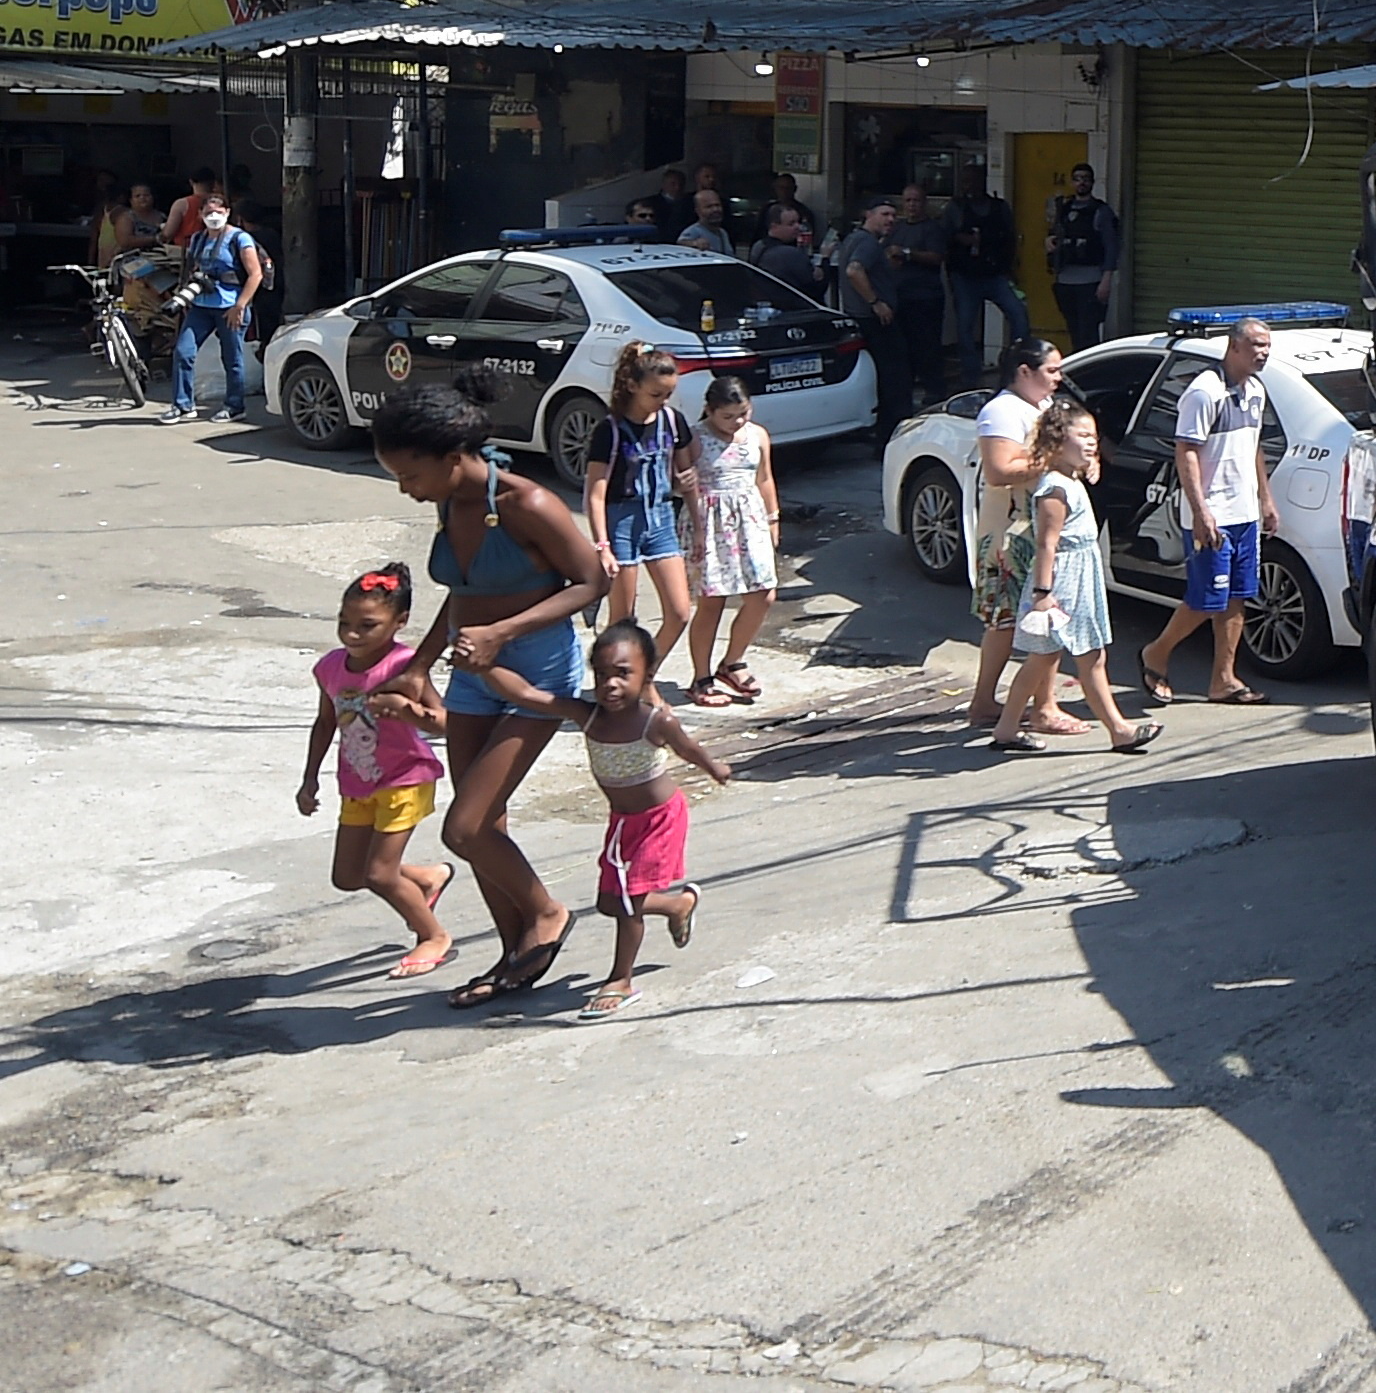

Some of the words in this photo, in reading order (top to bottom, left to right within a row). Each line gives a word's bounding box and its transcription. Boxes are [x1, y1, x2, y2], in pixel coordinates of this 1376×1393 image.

[53, 30, 92, 49] EM
[779, 57, 819, 70] PIZZA
[613, 324, 631, 335] DP
[765, 380, 802, 393] POLÍCIA
[1307, 447, 1331, 461] DP
